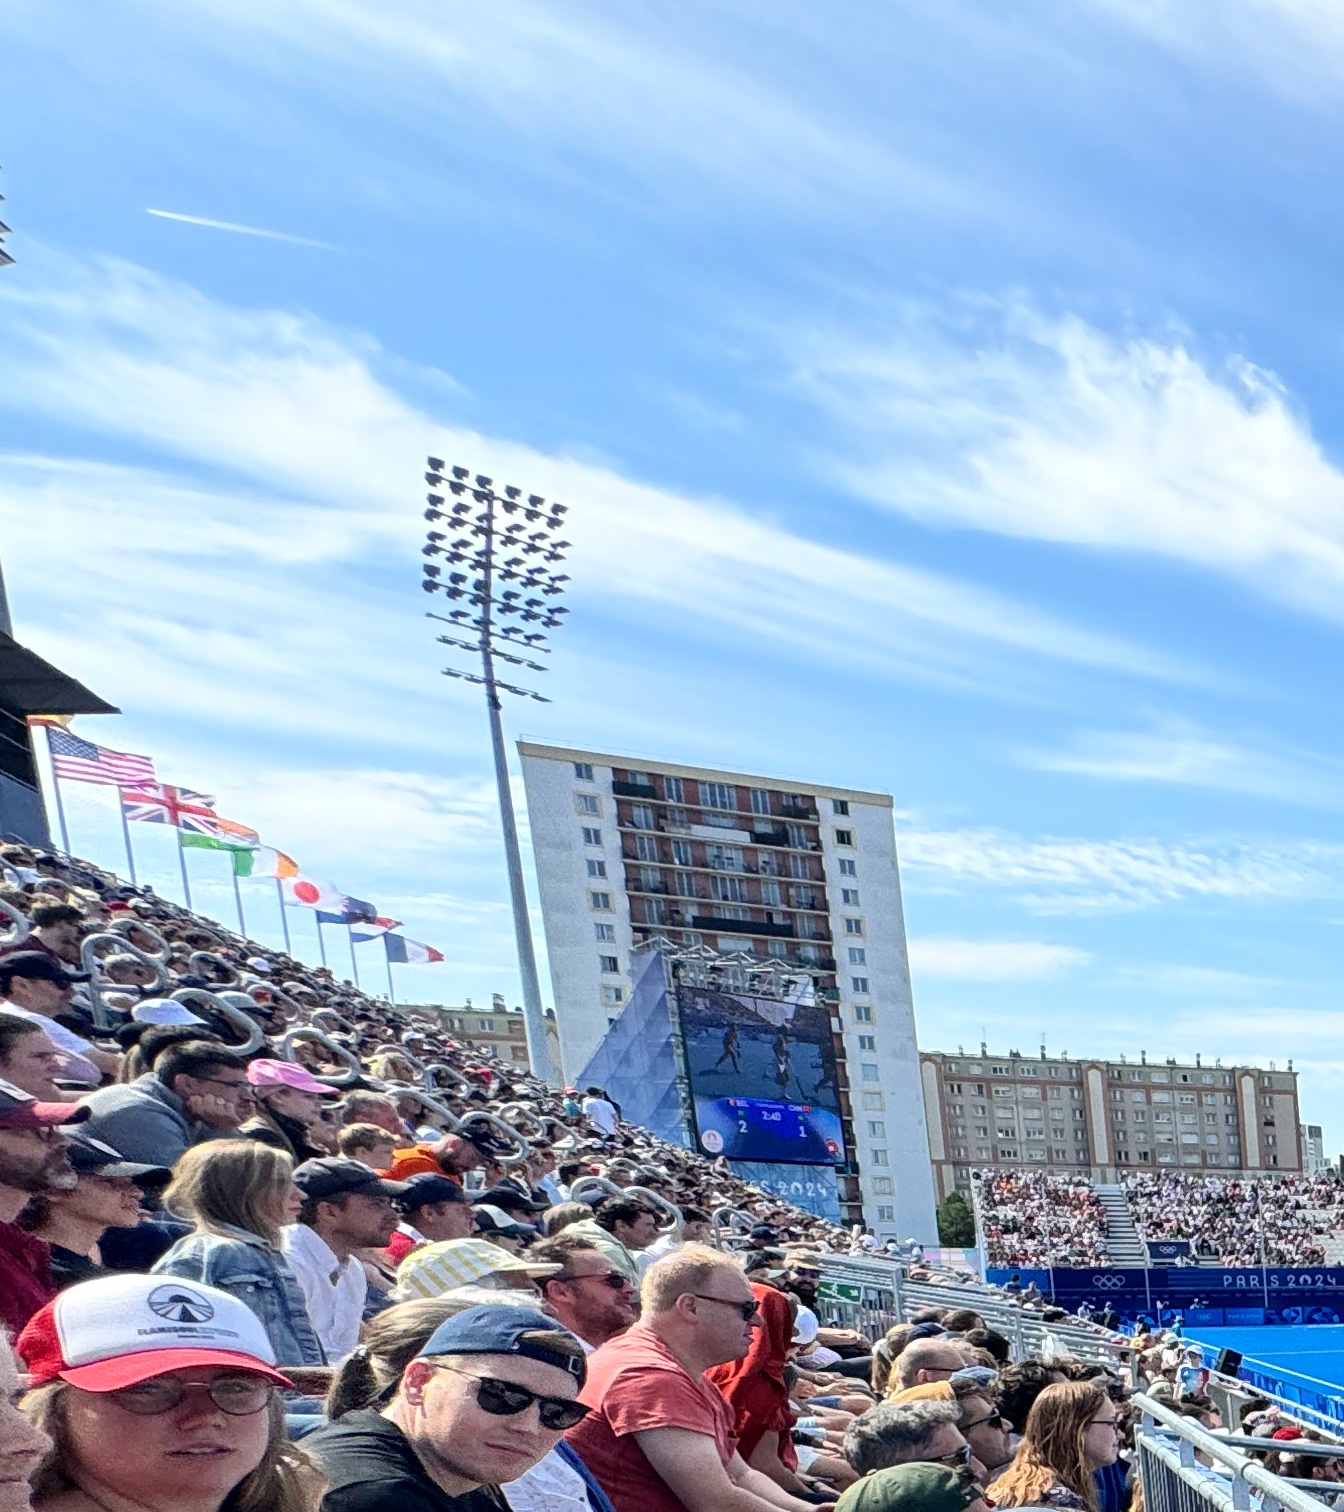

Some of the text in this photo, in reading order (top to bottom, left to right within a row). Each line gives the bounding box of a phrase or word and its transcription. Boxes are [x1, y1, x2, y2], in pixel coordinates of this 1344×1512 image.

[738, 1120, 748, 1133] 2
[799, 1125, 808, 1138] 1
[778, 1180, 828, 1198] 2024
[1223, 1274, 1337, 1288] PARS 2024
